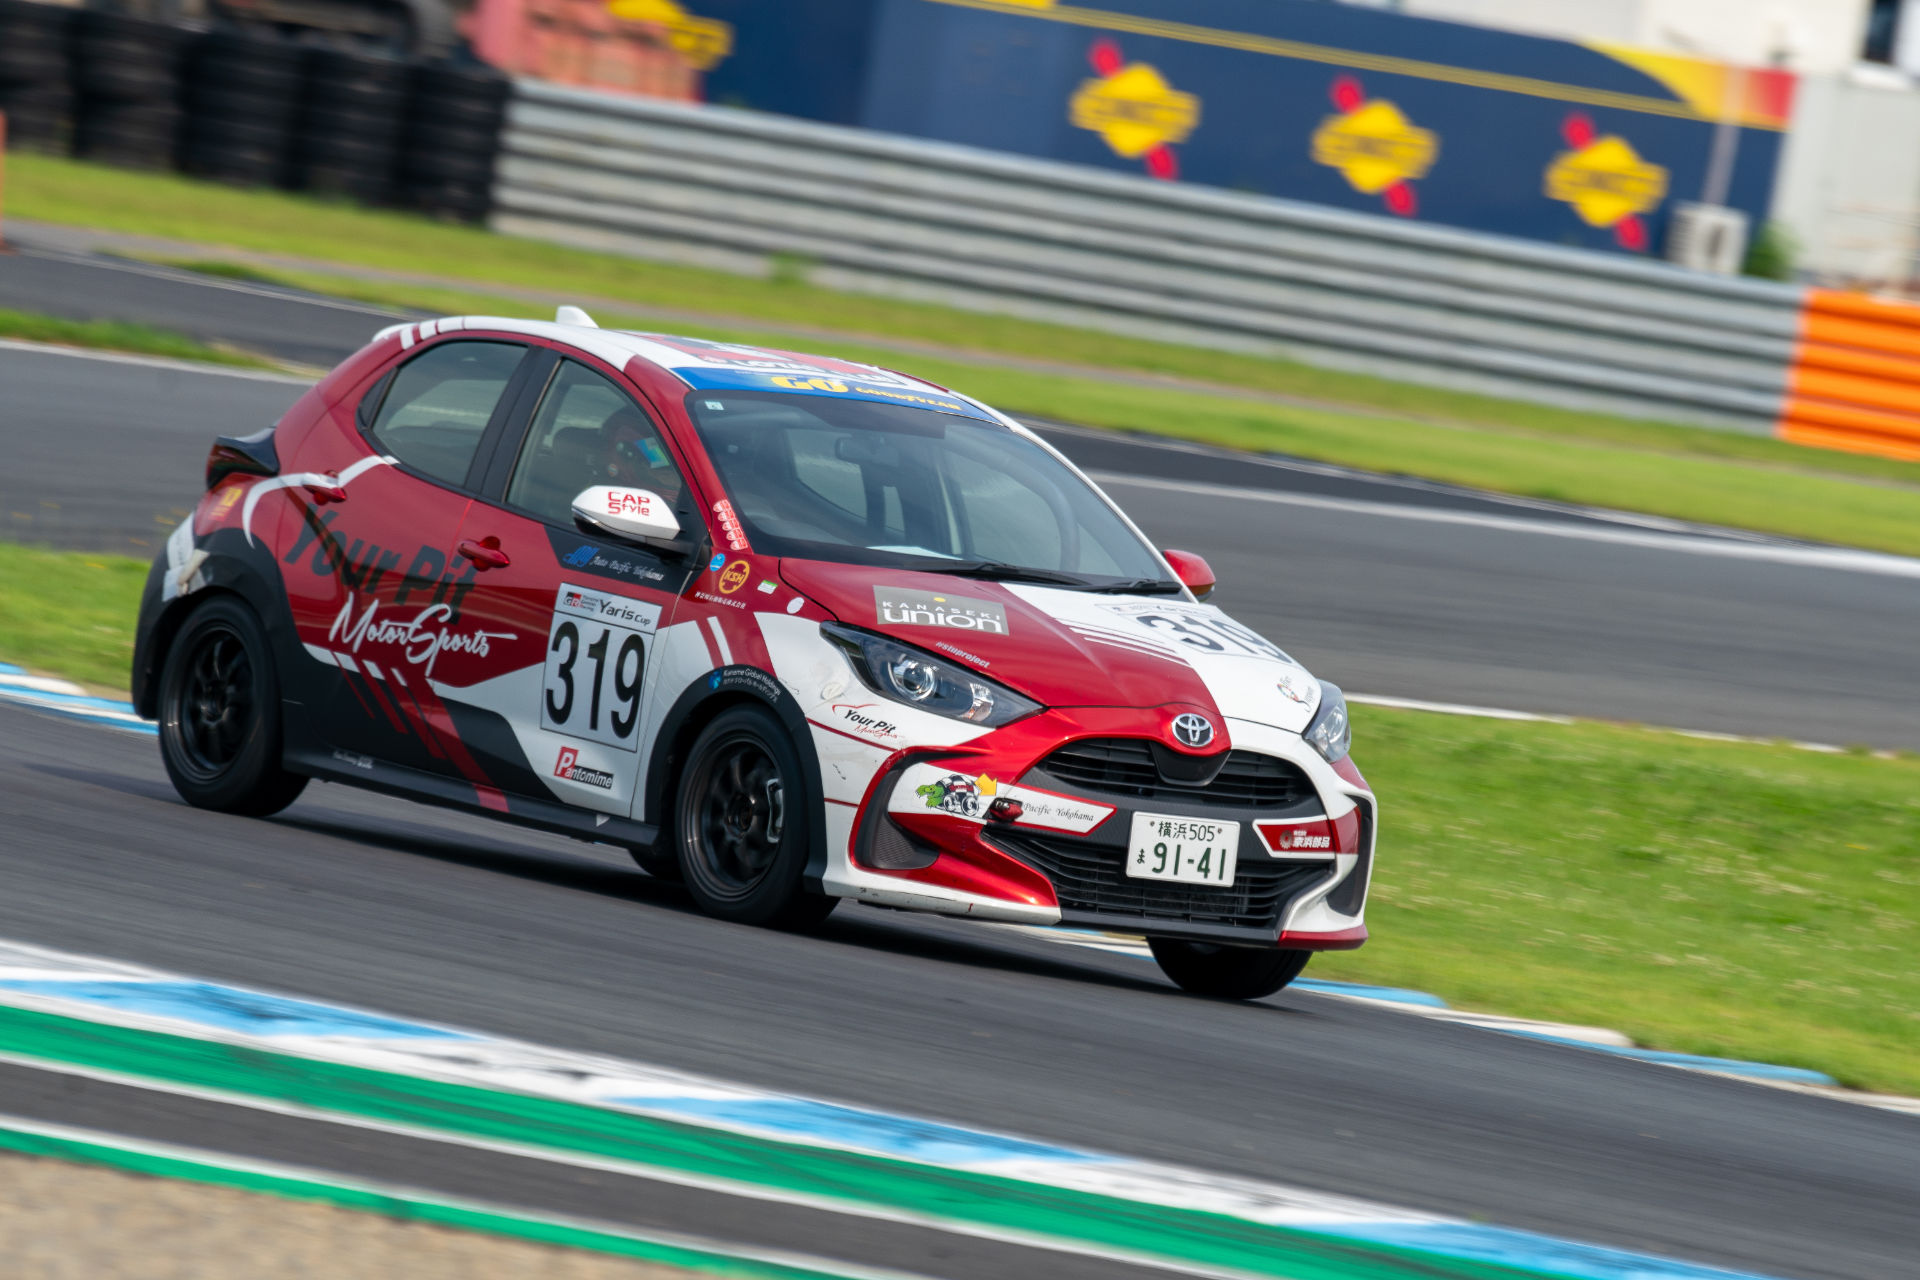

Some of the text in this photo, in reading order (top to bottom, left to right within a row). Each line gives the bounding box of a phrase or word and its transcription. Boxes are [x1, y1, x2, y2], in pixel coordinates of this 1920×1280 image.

[608, 491, 650, 505] CAP
[608, 502, 650, 516] Style
[283, 502, 478, 625] Your Pit
[724, 570, 744, 583] KSH
[599, 599, 635, 620] Yaris
[634, 614, 652, 626] Cup
[882, 601, 1000, 620] KANASEKI
[883, 608, 1003, 633] union
[1136, 615, 1293, 663] 319
[546, 621, 645, 739] 319
[844, 709, 896, 733] Your Pit
[556, 752, 613, 788] Pantomime
[1023, 802, 1095, 822] Pacific Yokohama
[1136, 842, 1227, 880] ま 91-41
